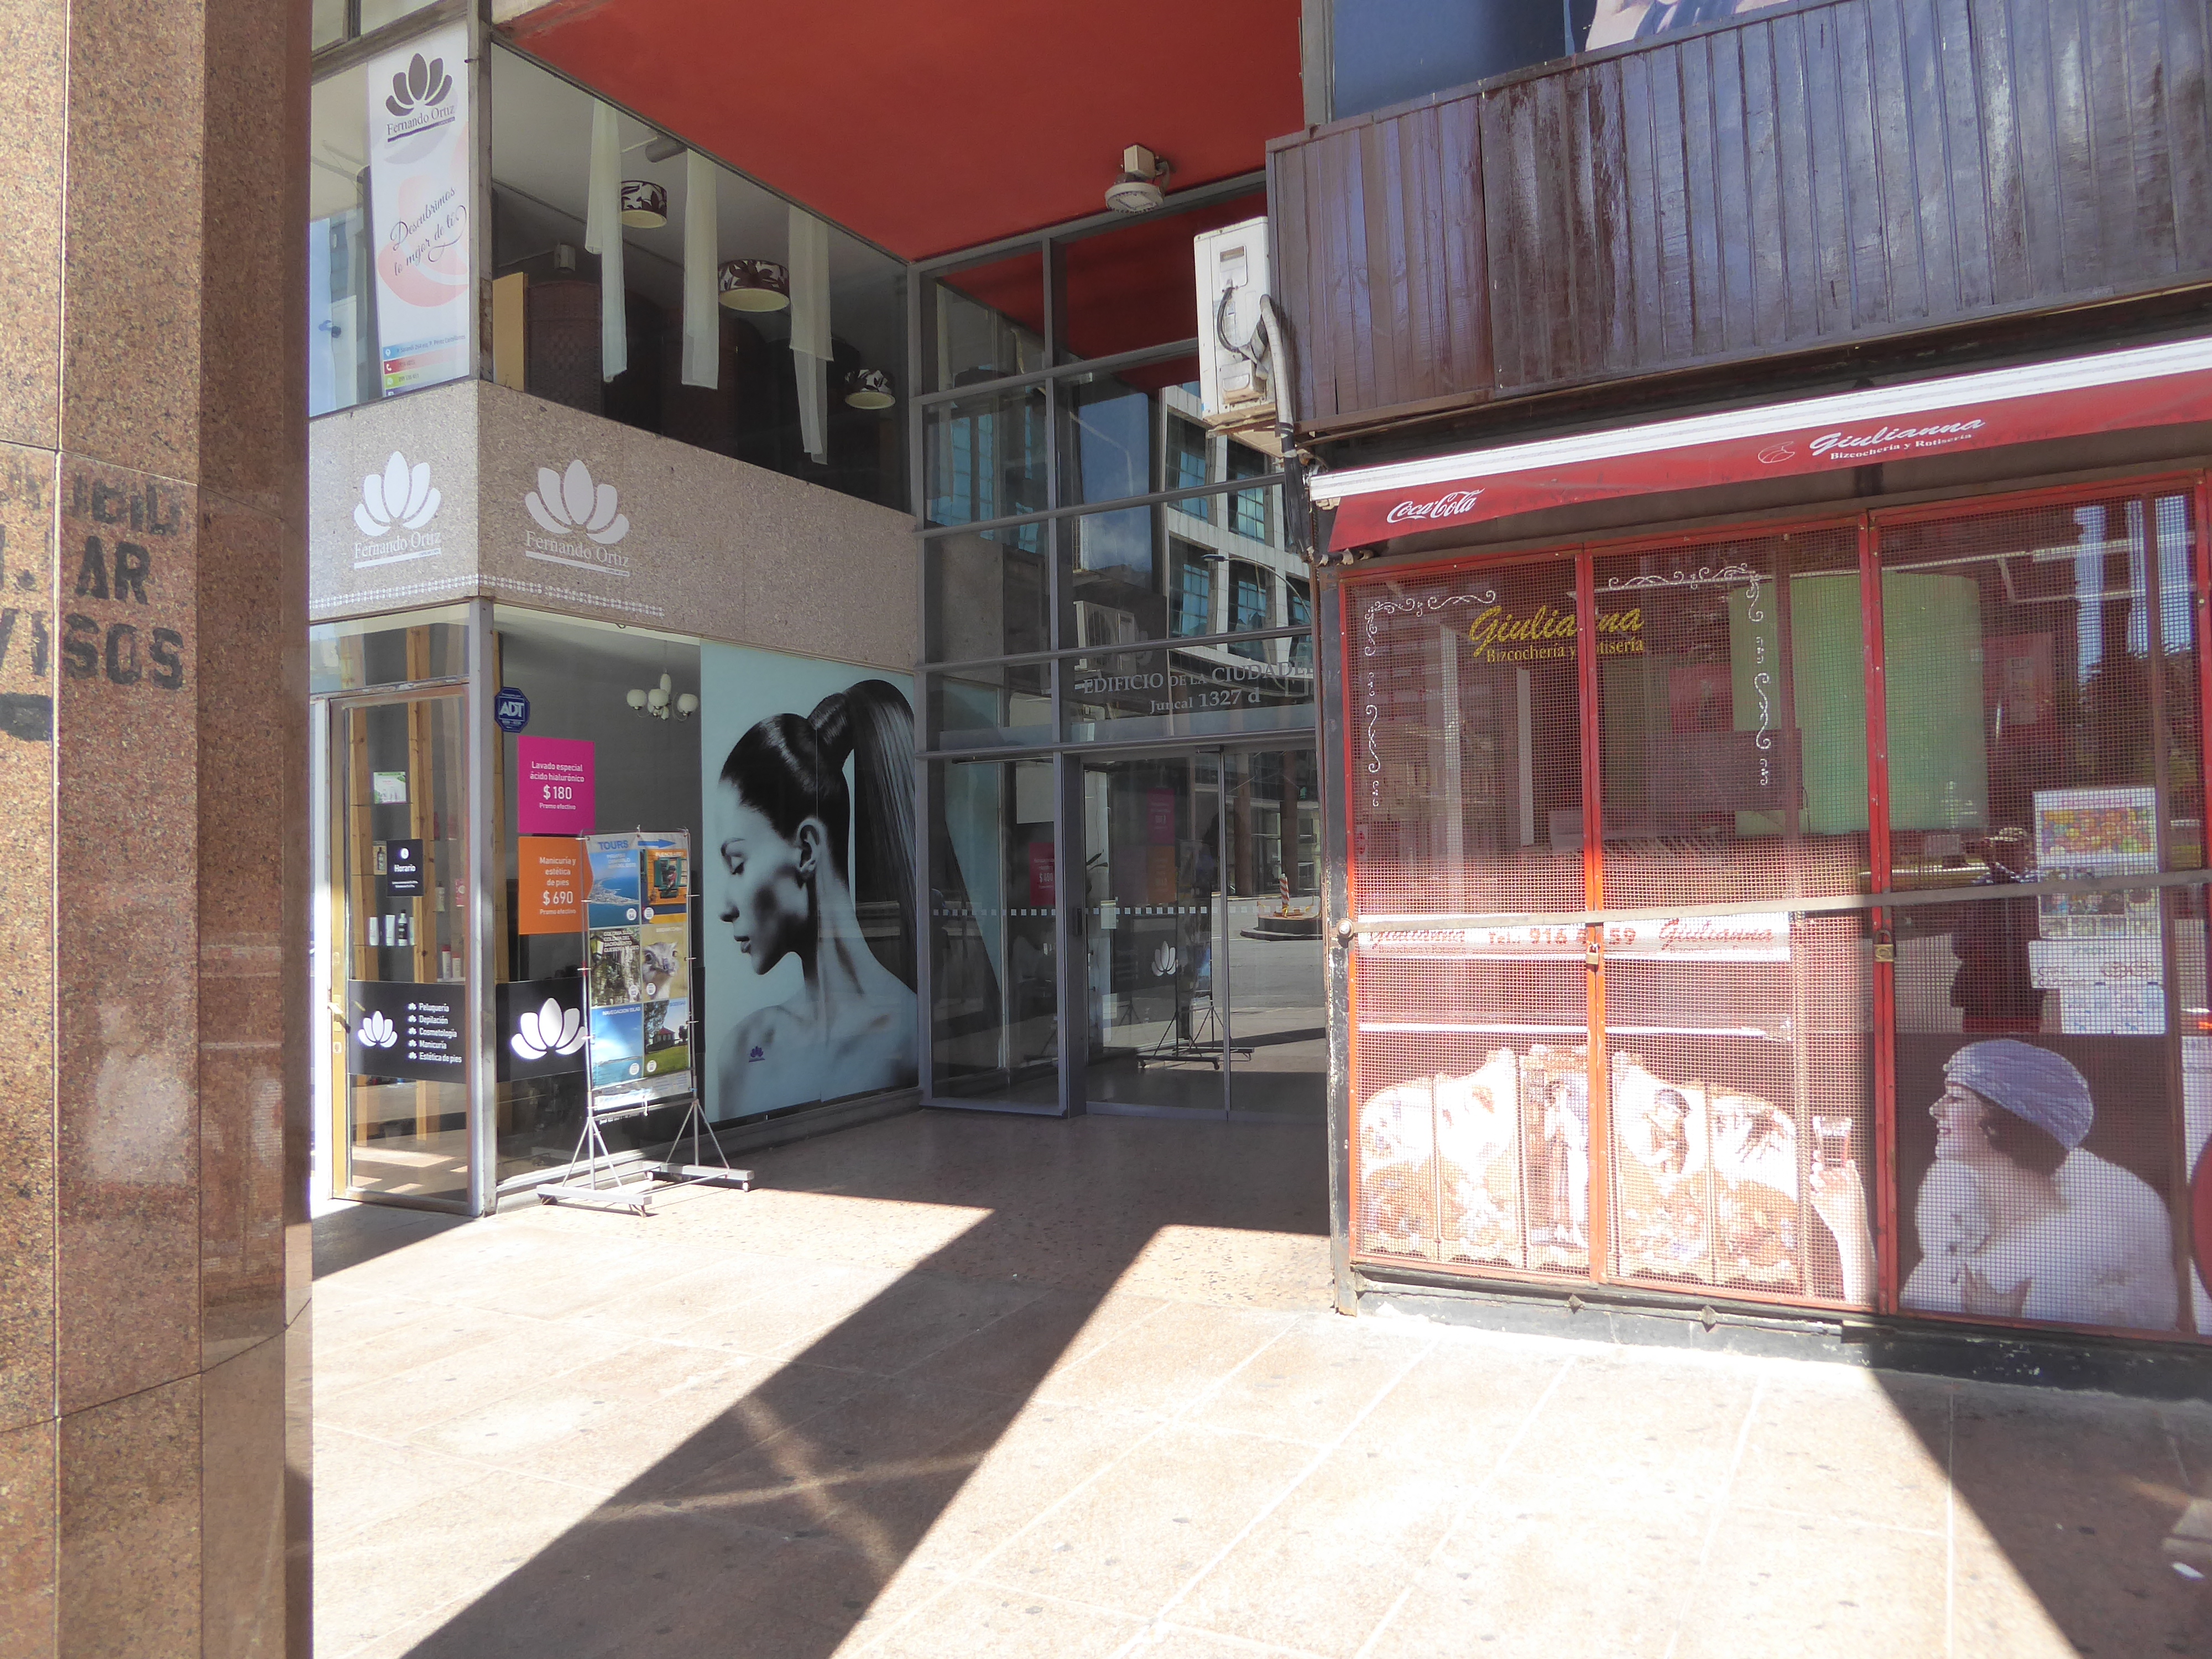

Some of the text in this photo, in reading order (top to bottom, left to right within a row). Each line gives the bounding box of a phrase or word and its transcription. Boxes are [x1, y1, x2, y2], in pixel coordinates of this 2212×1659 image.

[387, 113, 429, 135] Fernando
[390, 187, 455, 251] Descubrimos
[435, 223, 444, 241] de
[1809, 419, 1986, 456] Giulianna
[1830, 444, 1901, 460] Bizcochería
[1915, 434, 1971, 447] Rotisería
[1386, 488, 1485, 523] Coca-Cola
[354, 529, 441, 559] Fernando Ortiz
[525, 530, 629, 567] Fernando Ortiz
[1469, 605, 1645, 657] Giuliana
[1486, 643, 1564, 662] Bizcochería
[1567, 647, 1575, 660] y
[1083, 673, 1164, 693] EDIFICIO
[1170, 675, 1186, 687] DE
[1190, 674, 1207, 685] LA
[1150, 687, 1261, 714] Juncal 1327 d
[499, 701, 524, 717] ADT
[532, 761, 583, 772] Lavado especial
[530, 771, 585, 782] ácido hialurónico
[543, 784, 572, 800] $ 180
[598, 840, 629, 850] TOURS
[394, 863, 416, 872] Horario
[540, 856, 571, 864] Manicuría
[545, 867, 571, 875] estética
[556, 879, 569, 888] pies
[542, 890, 573, 905] $ 690
[419, 1003, 450, 1013] Peluquería
[419, 1015, 448, 1025] Depilación
[419, 1027, 457, 1039] Cosmetología
[419, 1040, 447, 1049] Manicuría
[419, 1052, 442, 1061] Estética
[450, 1054, 462, 1063] pies
